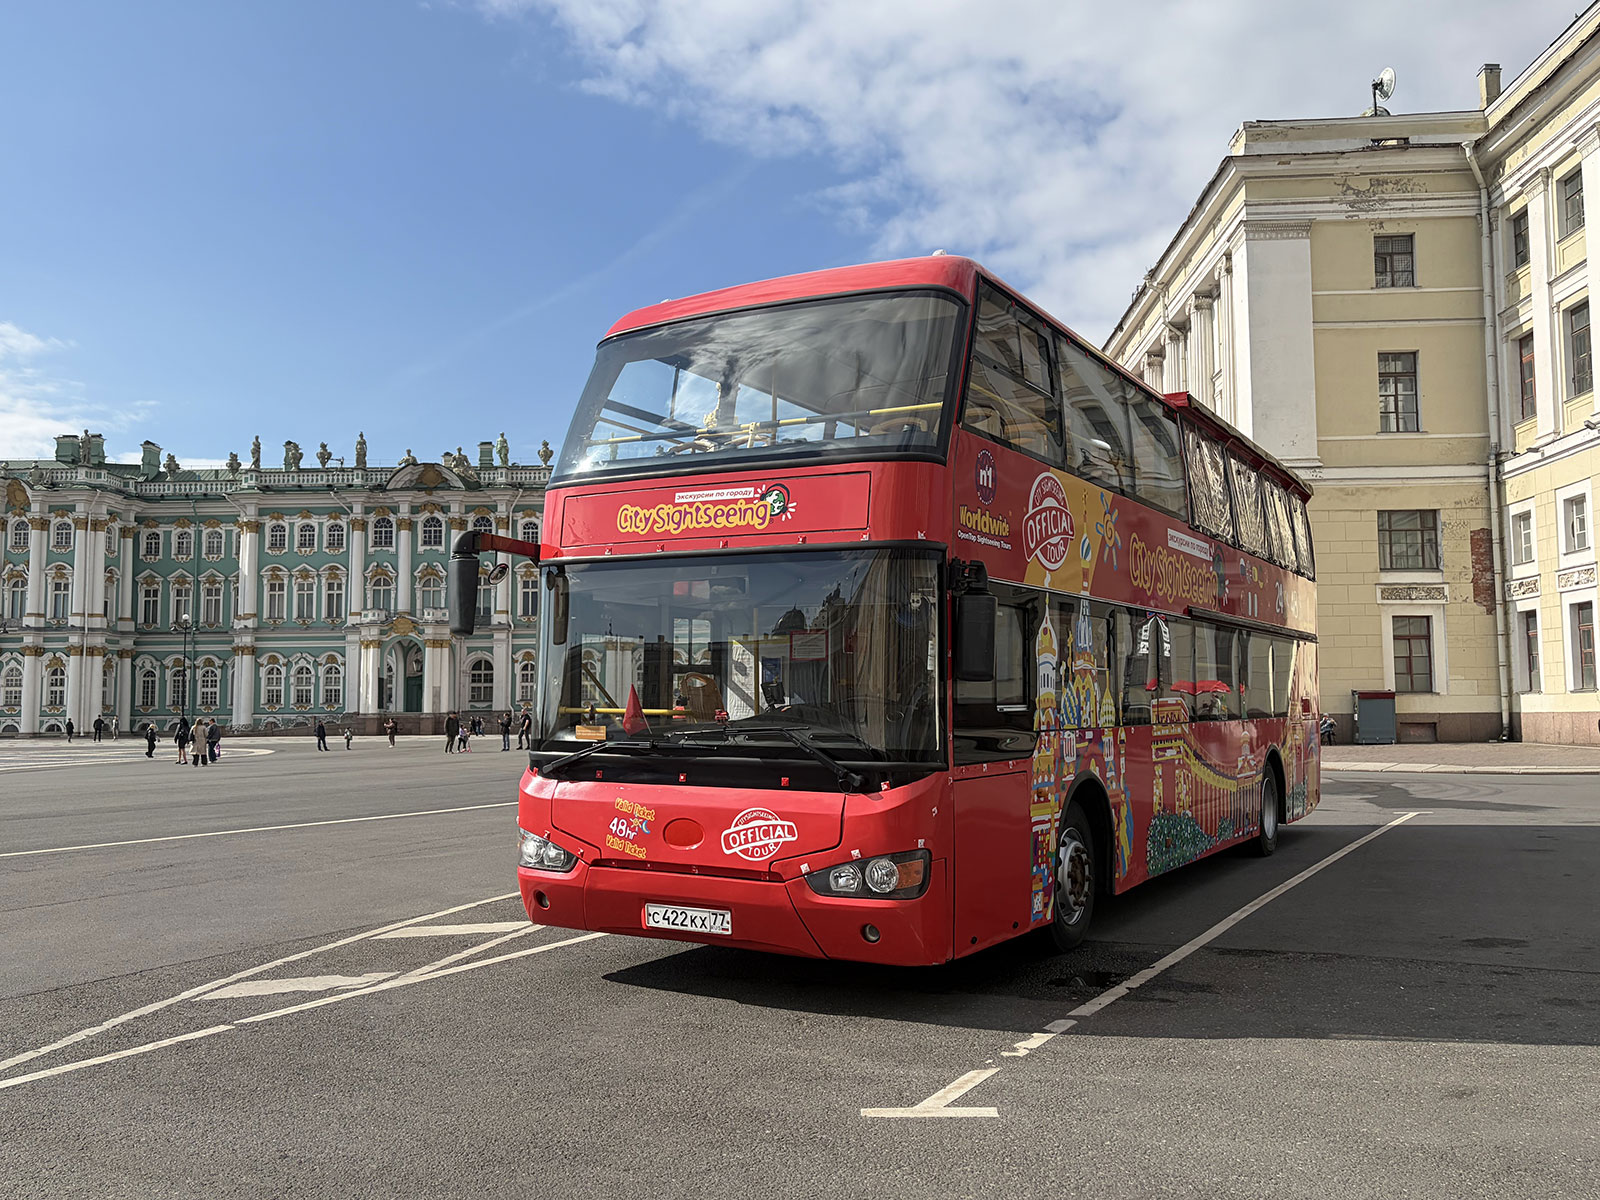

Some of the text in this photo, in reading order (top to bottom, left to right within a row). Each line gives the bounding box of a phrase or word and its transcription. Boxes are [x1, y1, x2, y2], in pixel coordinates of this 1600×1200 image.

[676, 492, 714, 501] экскурсии
[726, 489, 753, 498] городу
[959, 505, 1010, 537] Worldwide
[1027, 510, 1074, 549] OFFICIAL
[977, 534, 1001, 549] Sightseeing
[1000, 540, 1012, 550] Tours
[1046, 540, 1066, 562] TOUR
[615, 797, 656, 822] Valid Ticket
[606, 834, 647, 859] Valid Ticket
[729, 825, 793, 848] OFFICIAL
[748, 842, 777, 857] TOUR
[711, 912, 726, 926] 77
